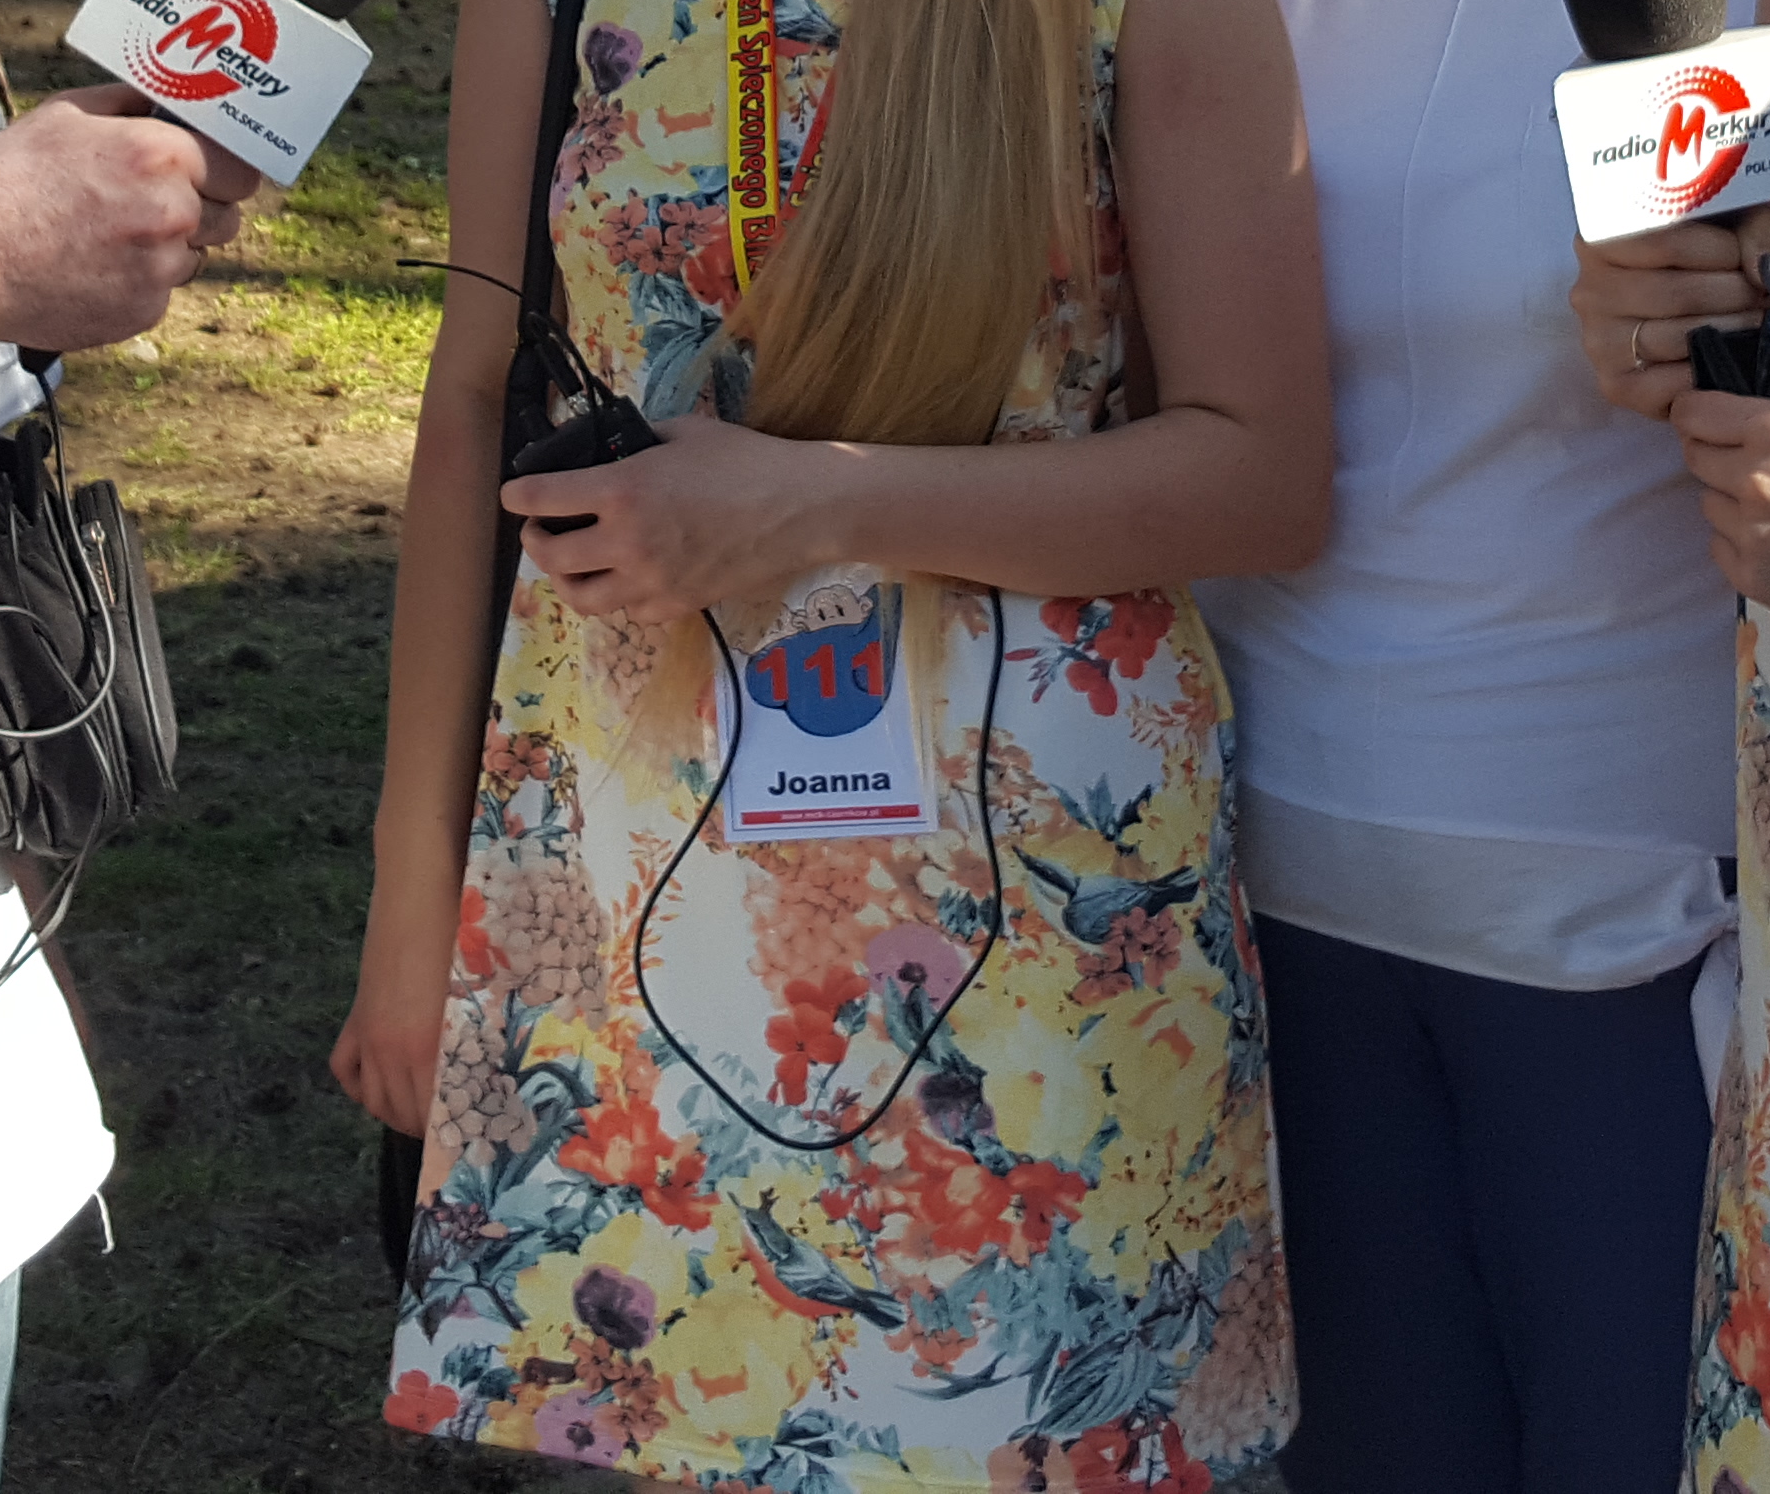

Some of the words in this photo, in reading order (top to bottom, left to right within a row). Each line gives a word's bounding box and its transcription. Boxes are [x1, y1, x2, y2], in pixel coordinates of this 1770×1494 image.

[154, 5, 291, 98] Merkury
[219, 100, 265, 135] POLSKIE
[263, 129, 298, 157] RADIO
[731, 30, 774, 209] Spieczonego
[1591, 134, 1658, 166] radio
[768, 771, 892, 796] Joanna
